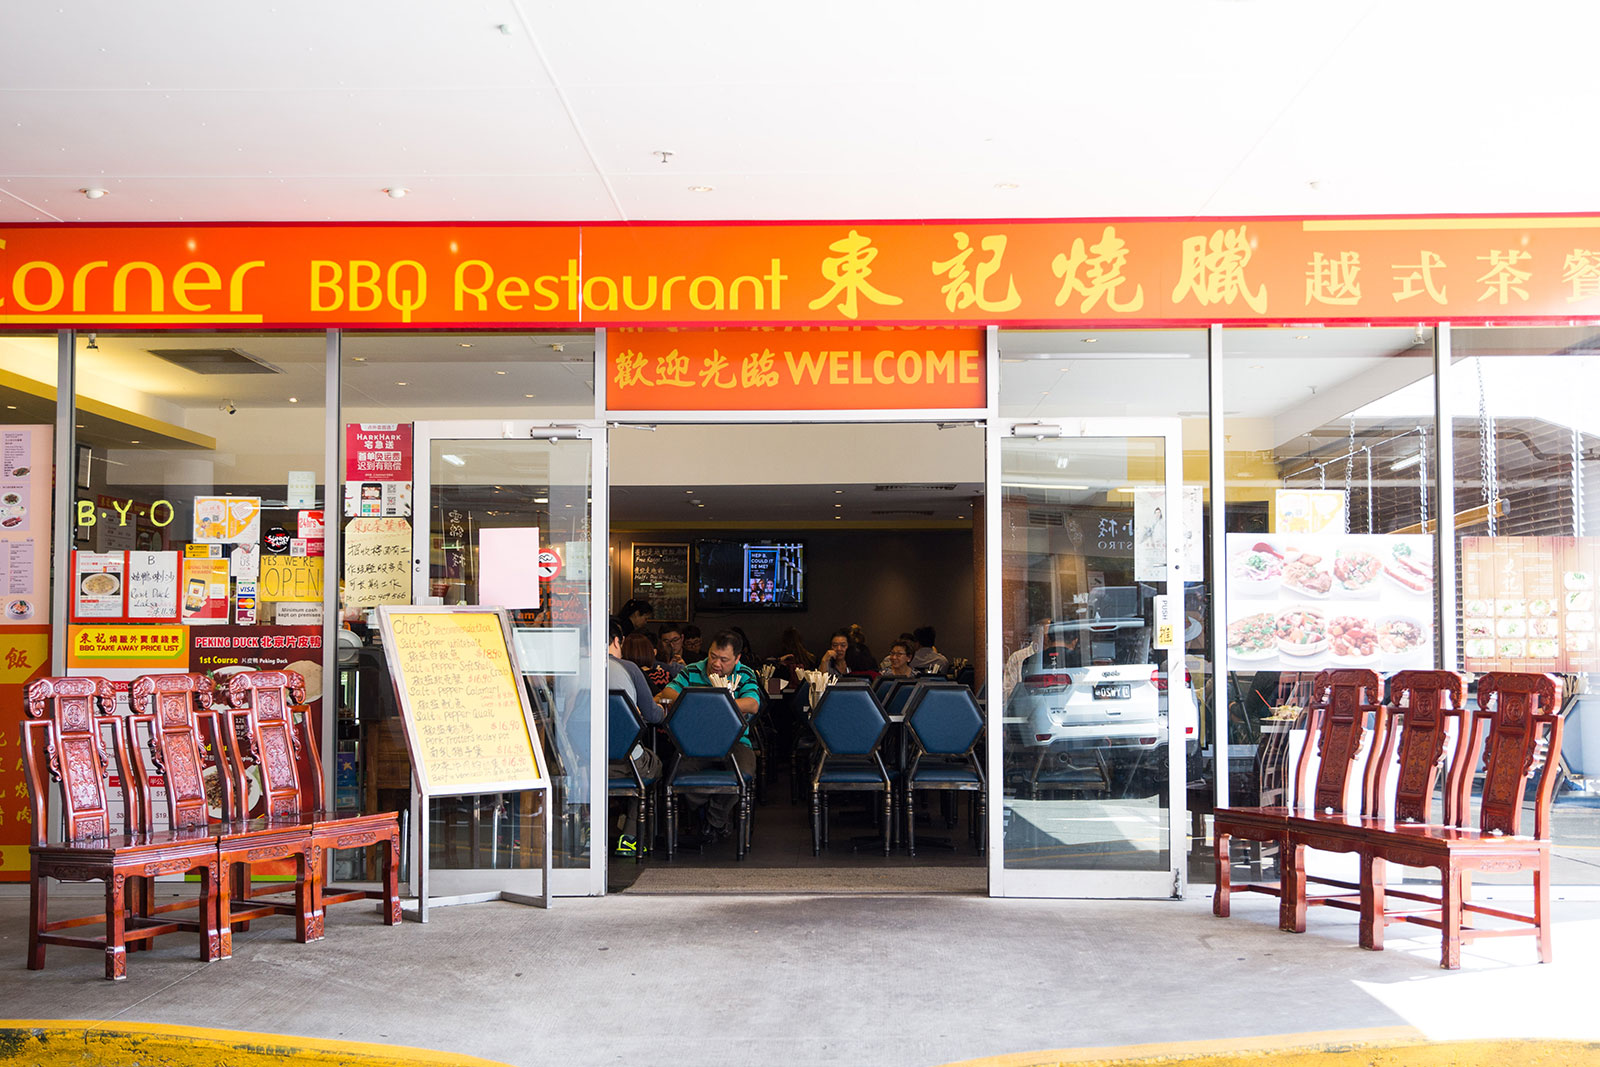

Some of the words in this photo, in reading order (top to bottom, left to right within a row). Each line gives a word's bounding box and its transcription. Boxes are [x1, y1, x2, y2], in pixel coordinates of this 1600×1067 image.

[0, 238, 265, 312] orner
[310, 259, 428, 323] BBQ
[453, 257, 789, 312] Restaurant
[613, 347, 780, 389] 歡迎光臨
[783, 350, 980, 385] WELCOME
[147, 555, 156, 566] B
[264, 567, 320, 598] OPEN
[195, 636, 231, 648] PEKING
[232, 636, 259, 648] DUCK
[400, 638, 417, 649] Salt
[4, 646, 33, 671] 飯
[199, 656, 211, 664] 1st
[212, 656, 239, 664] Course
[403, 662, 424, 674] Salt
[431, 662, 458, 673] pepper
[408, 686, 431, 697] Salt
[437, 686, 464, 697] pepper
[465, 684, 500, 696] Calamari
[416, 710, 436, 721] Salt
[443, 710, 471, 722] pepper
